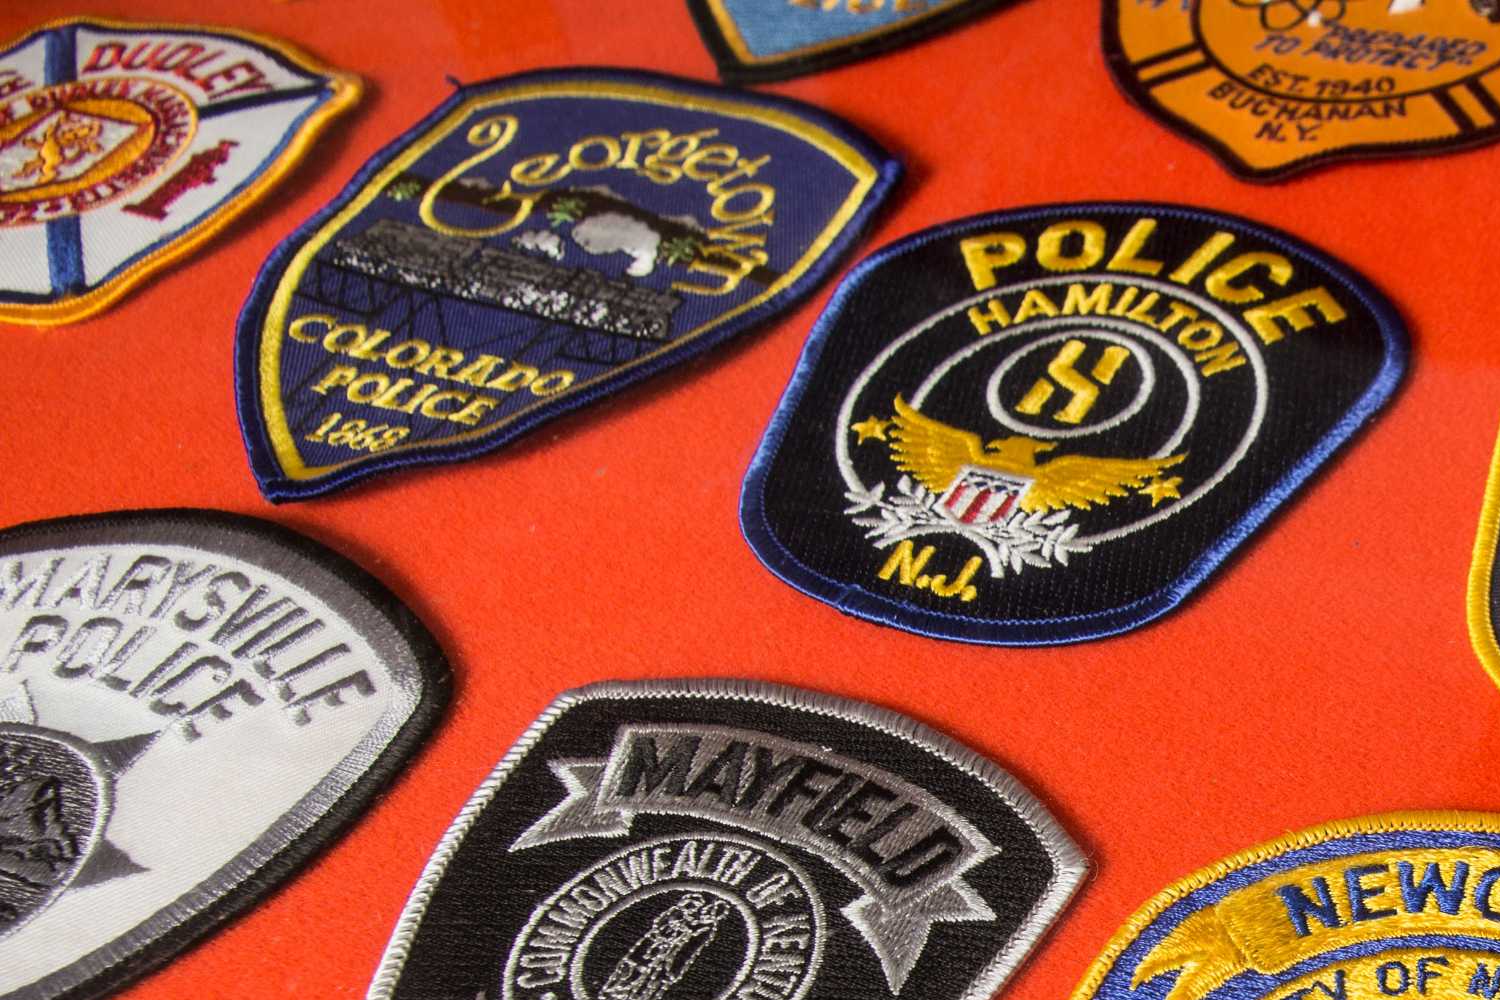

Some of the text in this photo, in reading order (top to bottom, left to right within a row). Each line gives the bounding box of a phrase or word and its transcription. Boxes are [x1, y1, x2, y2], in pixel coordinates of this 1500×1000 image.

[82, 41, 277, 98] DUDLEY
[1207, 81, 1407, 122] BUCHANAN
[1316, 76, 1396, 97] 1940
[959, 217, 1348, 346] POLICE
[287, 314, 575, 397] COLORADO
[967, 283, 1248, 378] HAMILTON
[310, 364, 502, 426] POLICE
[878, 540, 983, 602] N.J.
[4, 613, 265, 743] POLICE
[616, 735, 964, 888] MAYFIELD
[517, 841, 760, 989] COMMONWEALTH
[746, 872, 804, 912] OF
[1376, 956, 1450, 996] OF
